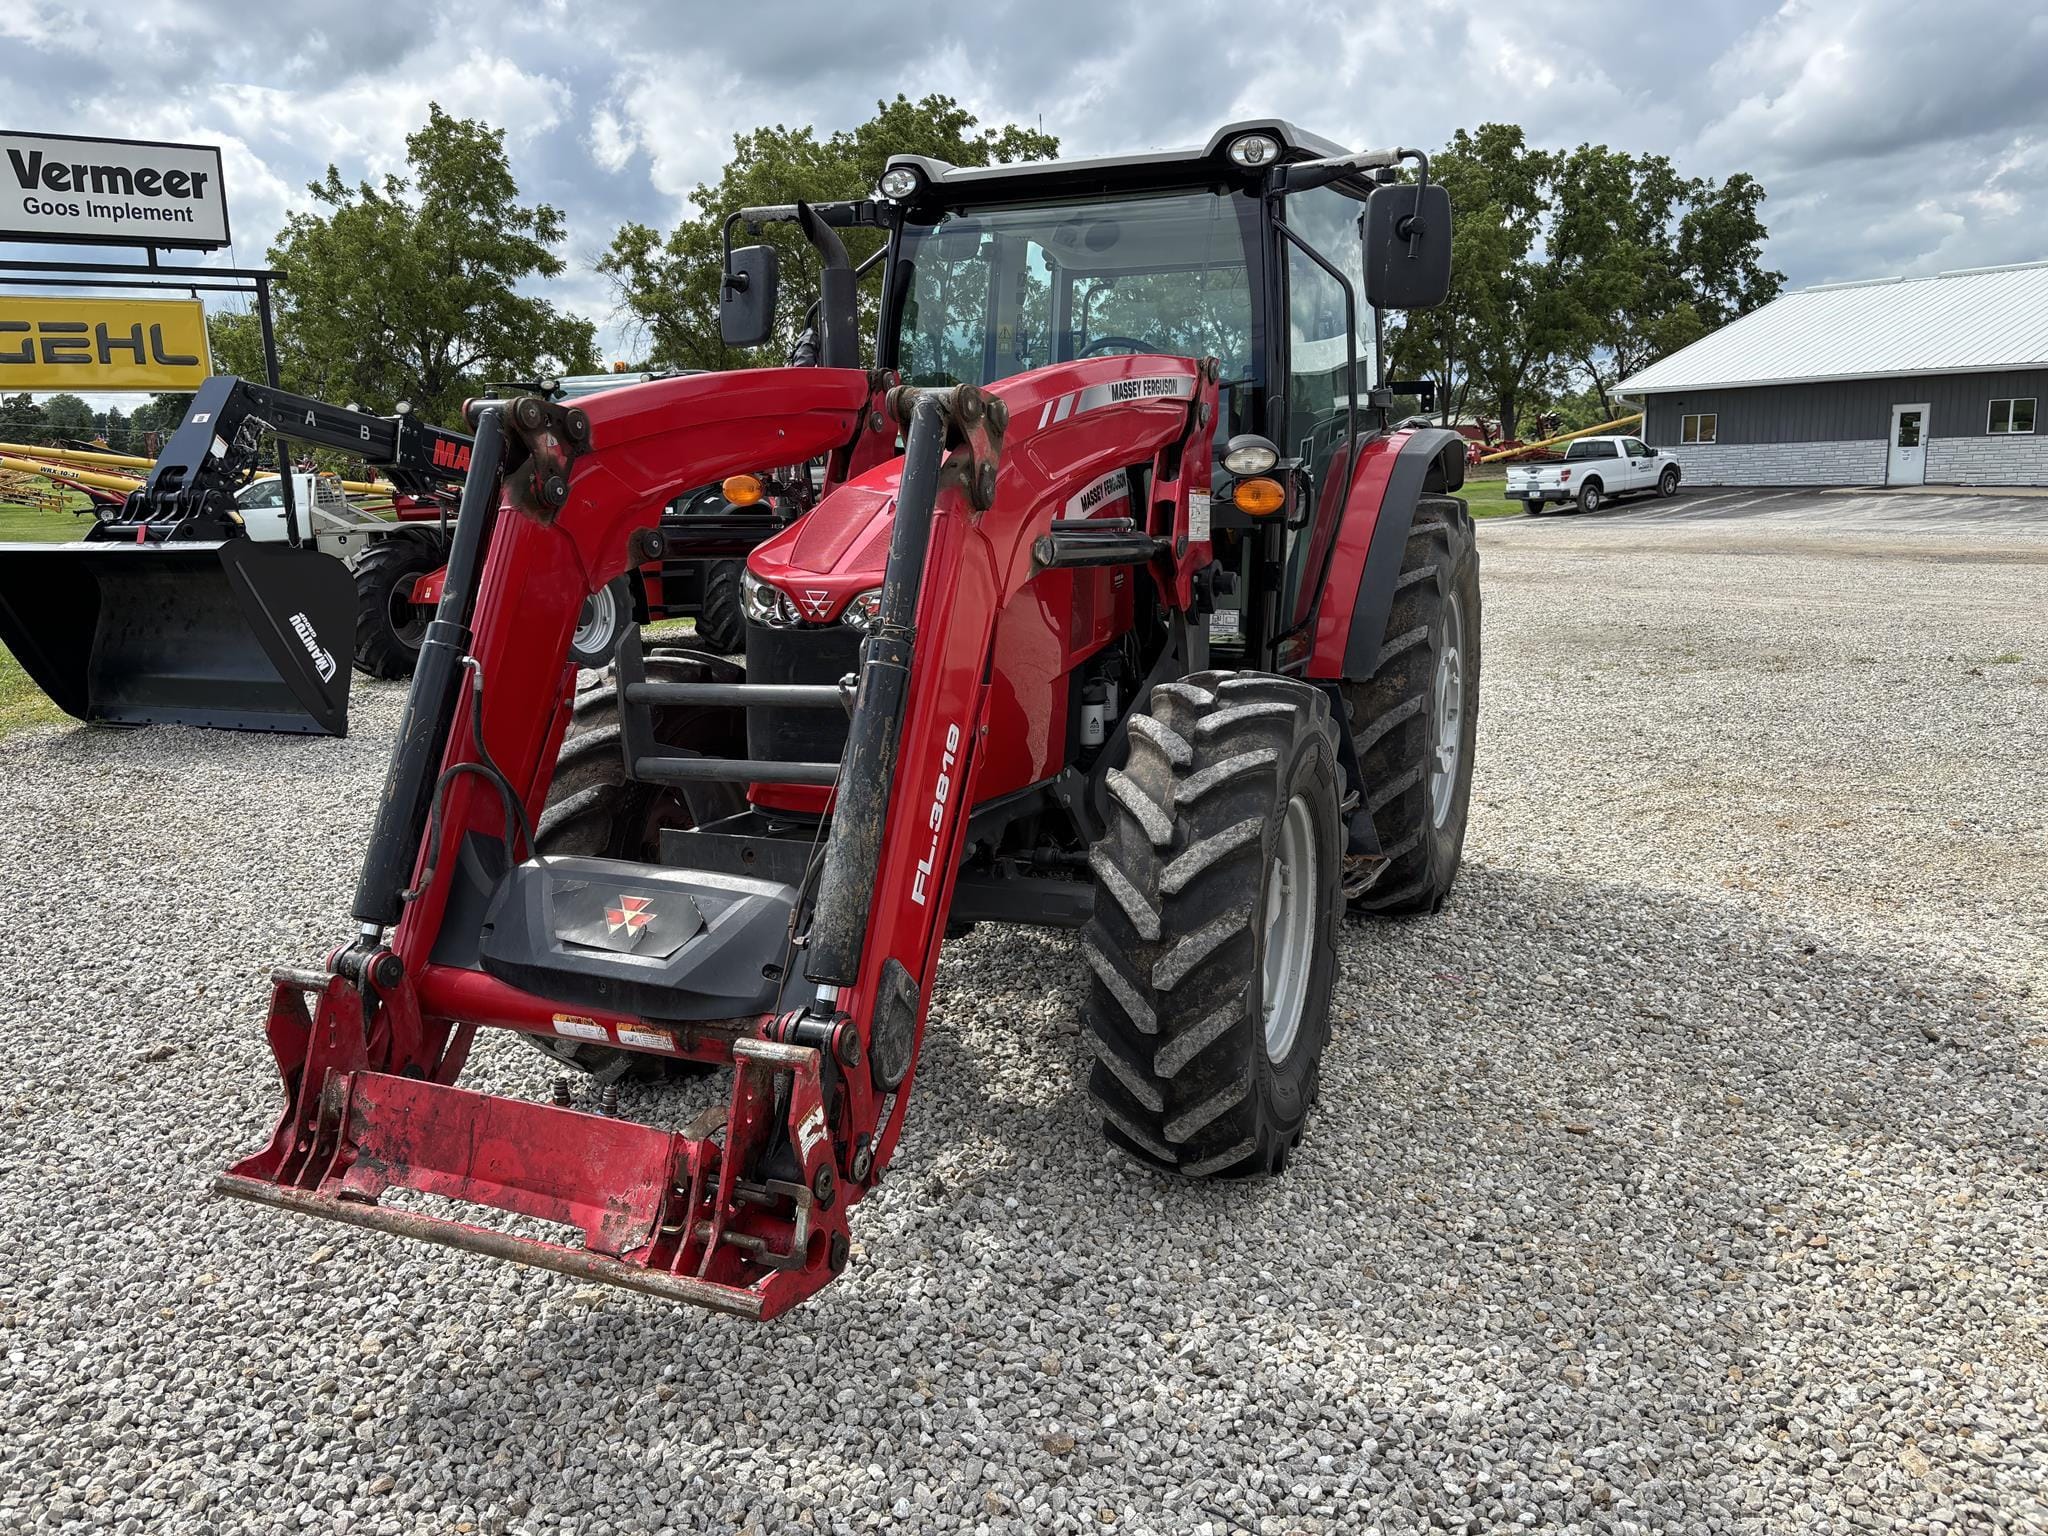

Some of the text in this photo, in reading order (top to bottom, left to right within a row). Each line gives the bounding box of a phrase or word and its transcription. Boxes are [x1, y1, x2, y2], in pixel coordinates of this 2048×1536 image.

[7, 149, 208, 199] Vermeer
[23, 197, 194, 223] Goos Implement
[0, 321, 199, 366] GEHL
[1111, 378, 1178, 402] MASSEY FERGUSON
[305, 410, 316, 427] A
[360, 425, 371, 441] B
[1080, 482, 1104, 512] MASSEY
[299, 612, 317, 637] GROUP
[289, 614, 329, 671] MANITOU
